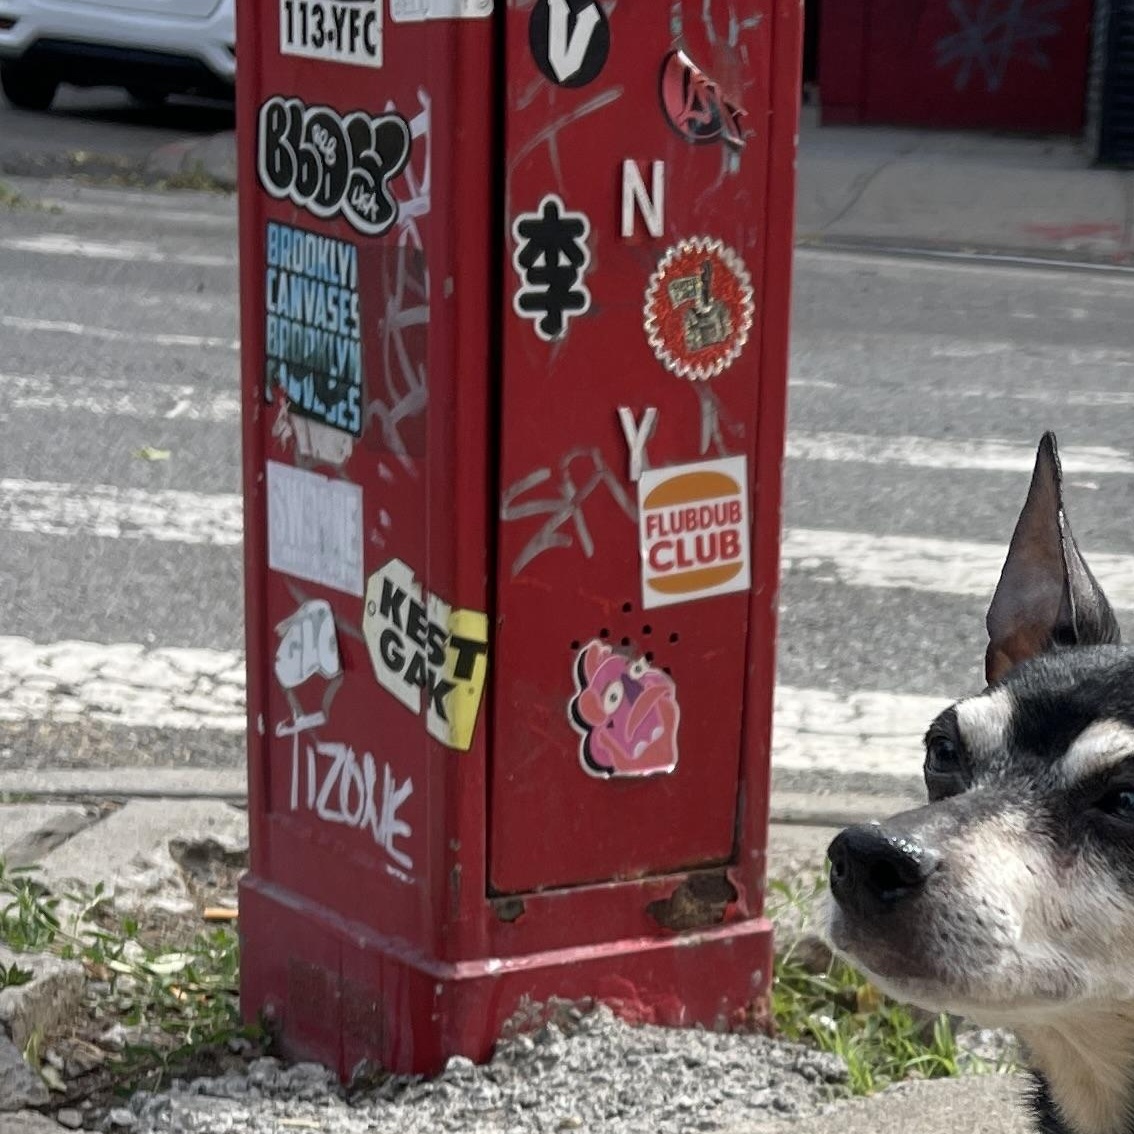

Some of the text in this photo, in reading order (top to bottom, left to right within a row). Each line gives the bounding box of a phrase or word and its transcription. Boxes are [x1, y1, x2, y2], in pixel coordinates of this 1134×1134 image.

[622, 159, 664, 237] N
[618, 406, 657, 481] Y
[645, 500, 742, 540] FLUBDUB
[648, 529, 741, 573] CLUB
[379, 577, 488, 682] KEST
[379, 628, 458, 722] GAK
